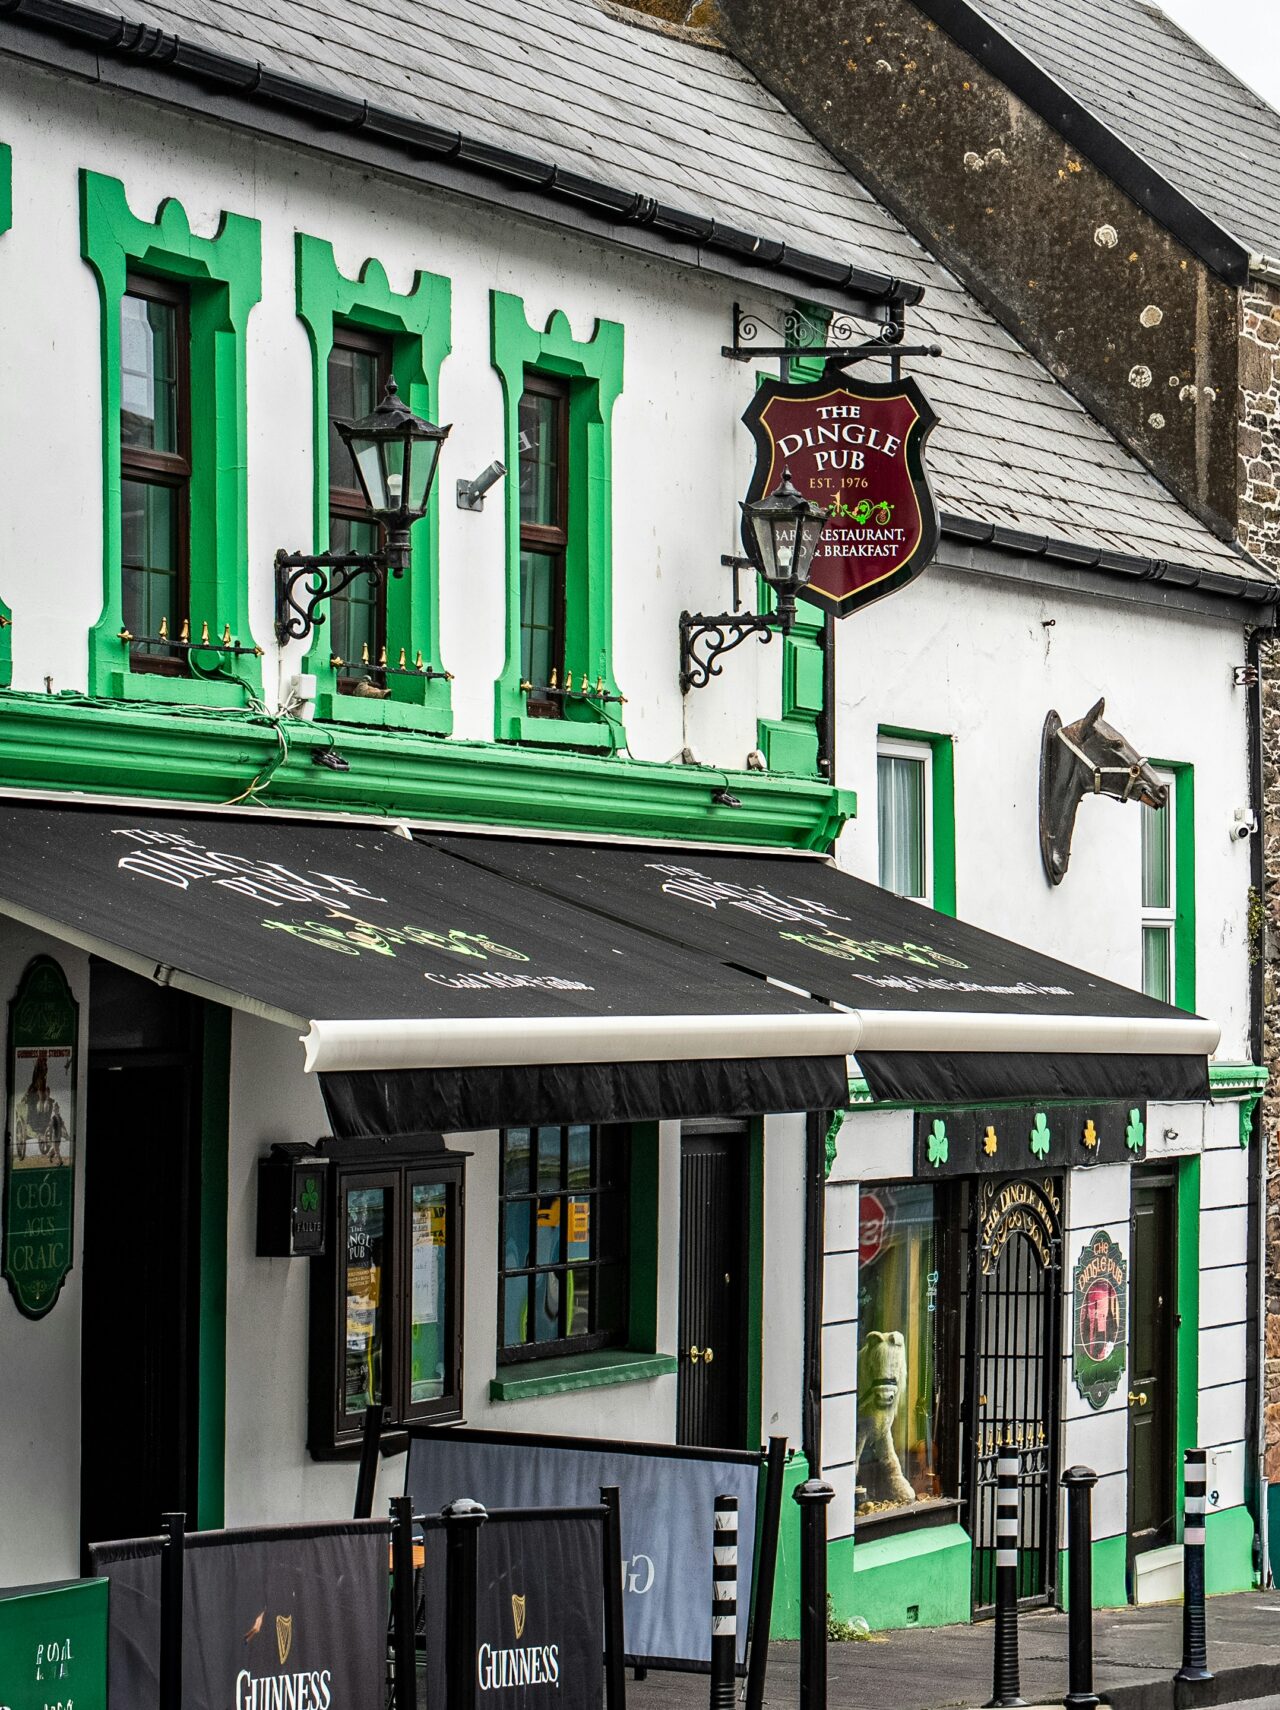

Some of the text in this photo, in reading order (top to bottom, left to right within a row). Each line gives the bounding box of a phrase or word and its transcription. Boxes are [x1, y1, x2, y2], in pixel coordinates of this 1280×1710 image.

[816, 405, 861, 420] THE
[776, 423, 901, 458] DINGLE
[814, 449, 865, 472] PUB
[809, 477, 868, 489] EST. 1976
[802, 529, 813, 541] &
[824, 544, 899, 557] BREAKFAST
[111, 828, 206, 849] THE
[118, 846, 388, 903] DINGLE
[212, 876, 351, 909] PUB
[661, 877, 852, 921] DINGLE
[16, 1173, 63, 1209] CEÓL
[1000, 1183, 1037, 1213] DINGLE
[24, 1216, 55, 1238] AGUS
[13, 1242, 64, 1272] CRAIC
[349, 1245, 366, 1260] PUB
[478, 1642, 559, 1691] GUINNESS
[235, 1669, 331, 1710] GUINNESS
